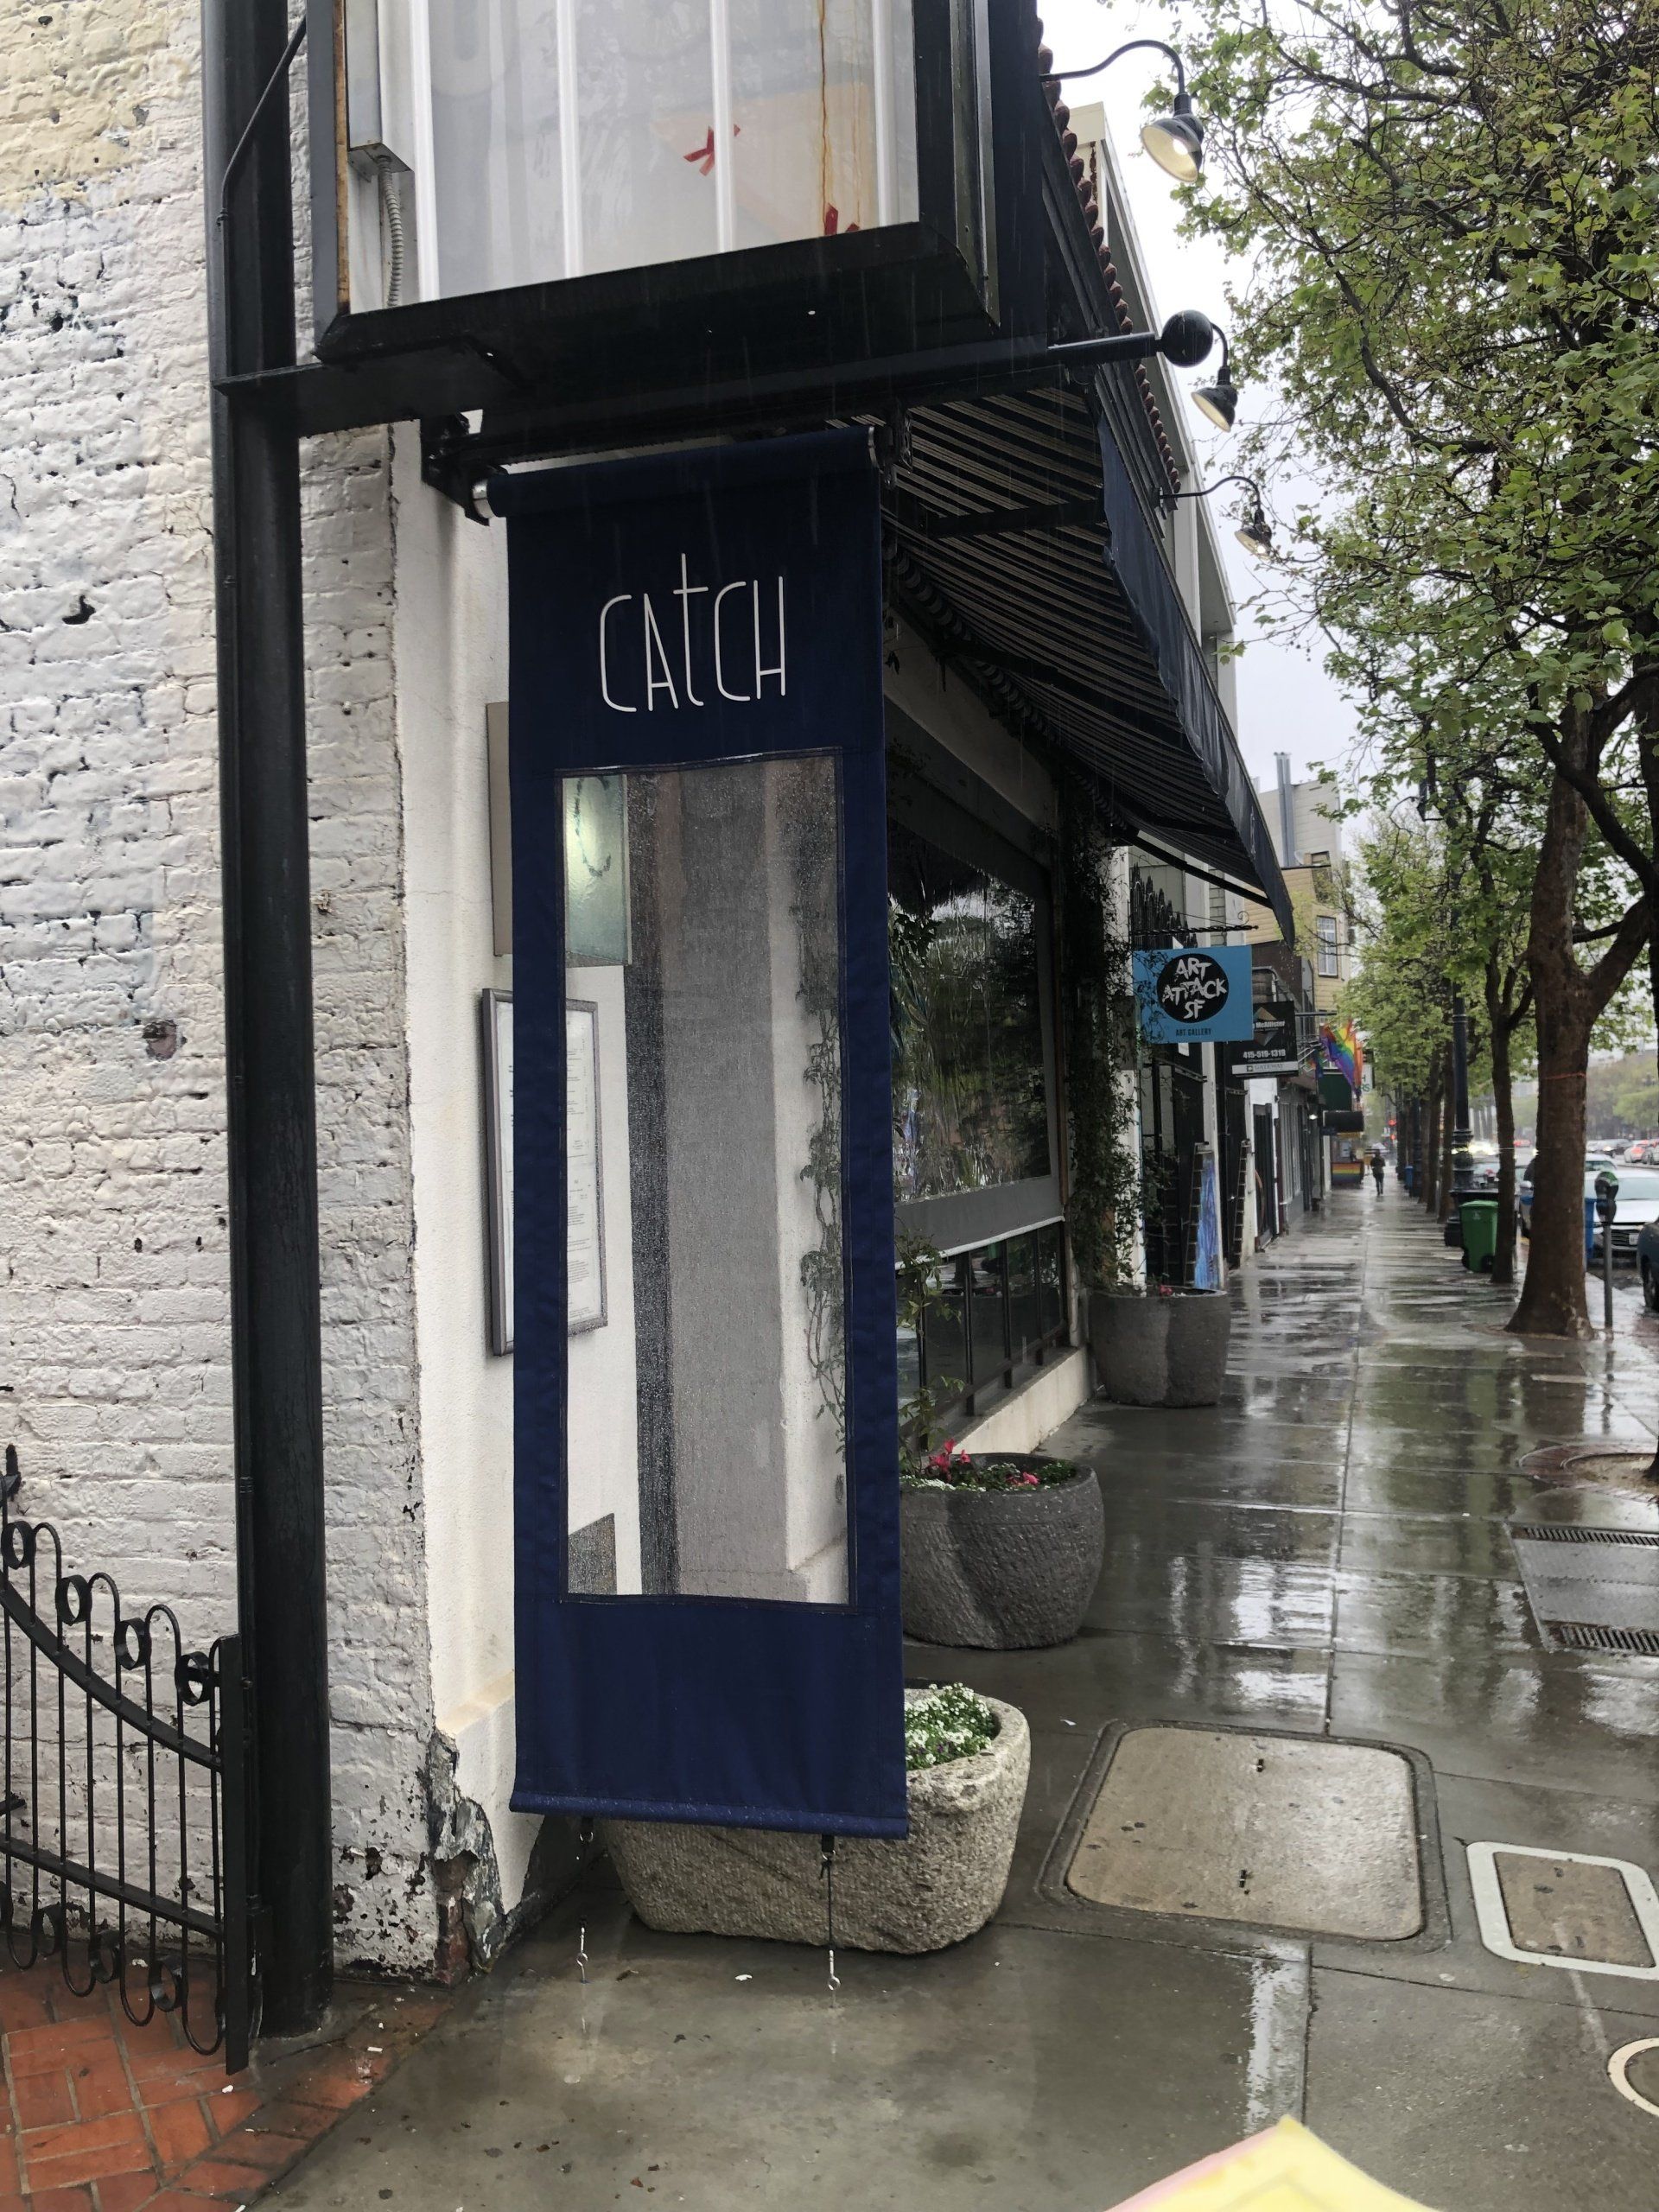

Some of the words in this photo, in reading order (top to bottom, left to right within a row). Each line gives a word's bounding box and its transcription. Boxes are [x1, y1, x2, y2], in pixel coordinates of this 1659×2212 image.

[1174, 957, 1212, 982] ART
[1161, 976, 1227, 1006] ATTACK
[1183, 999, 1205, 1020] SF
[1188, 1027, 1211, 1037] GALLERY
